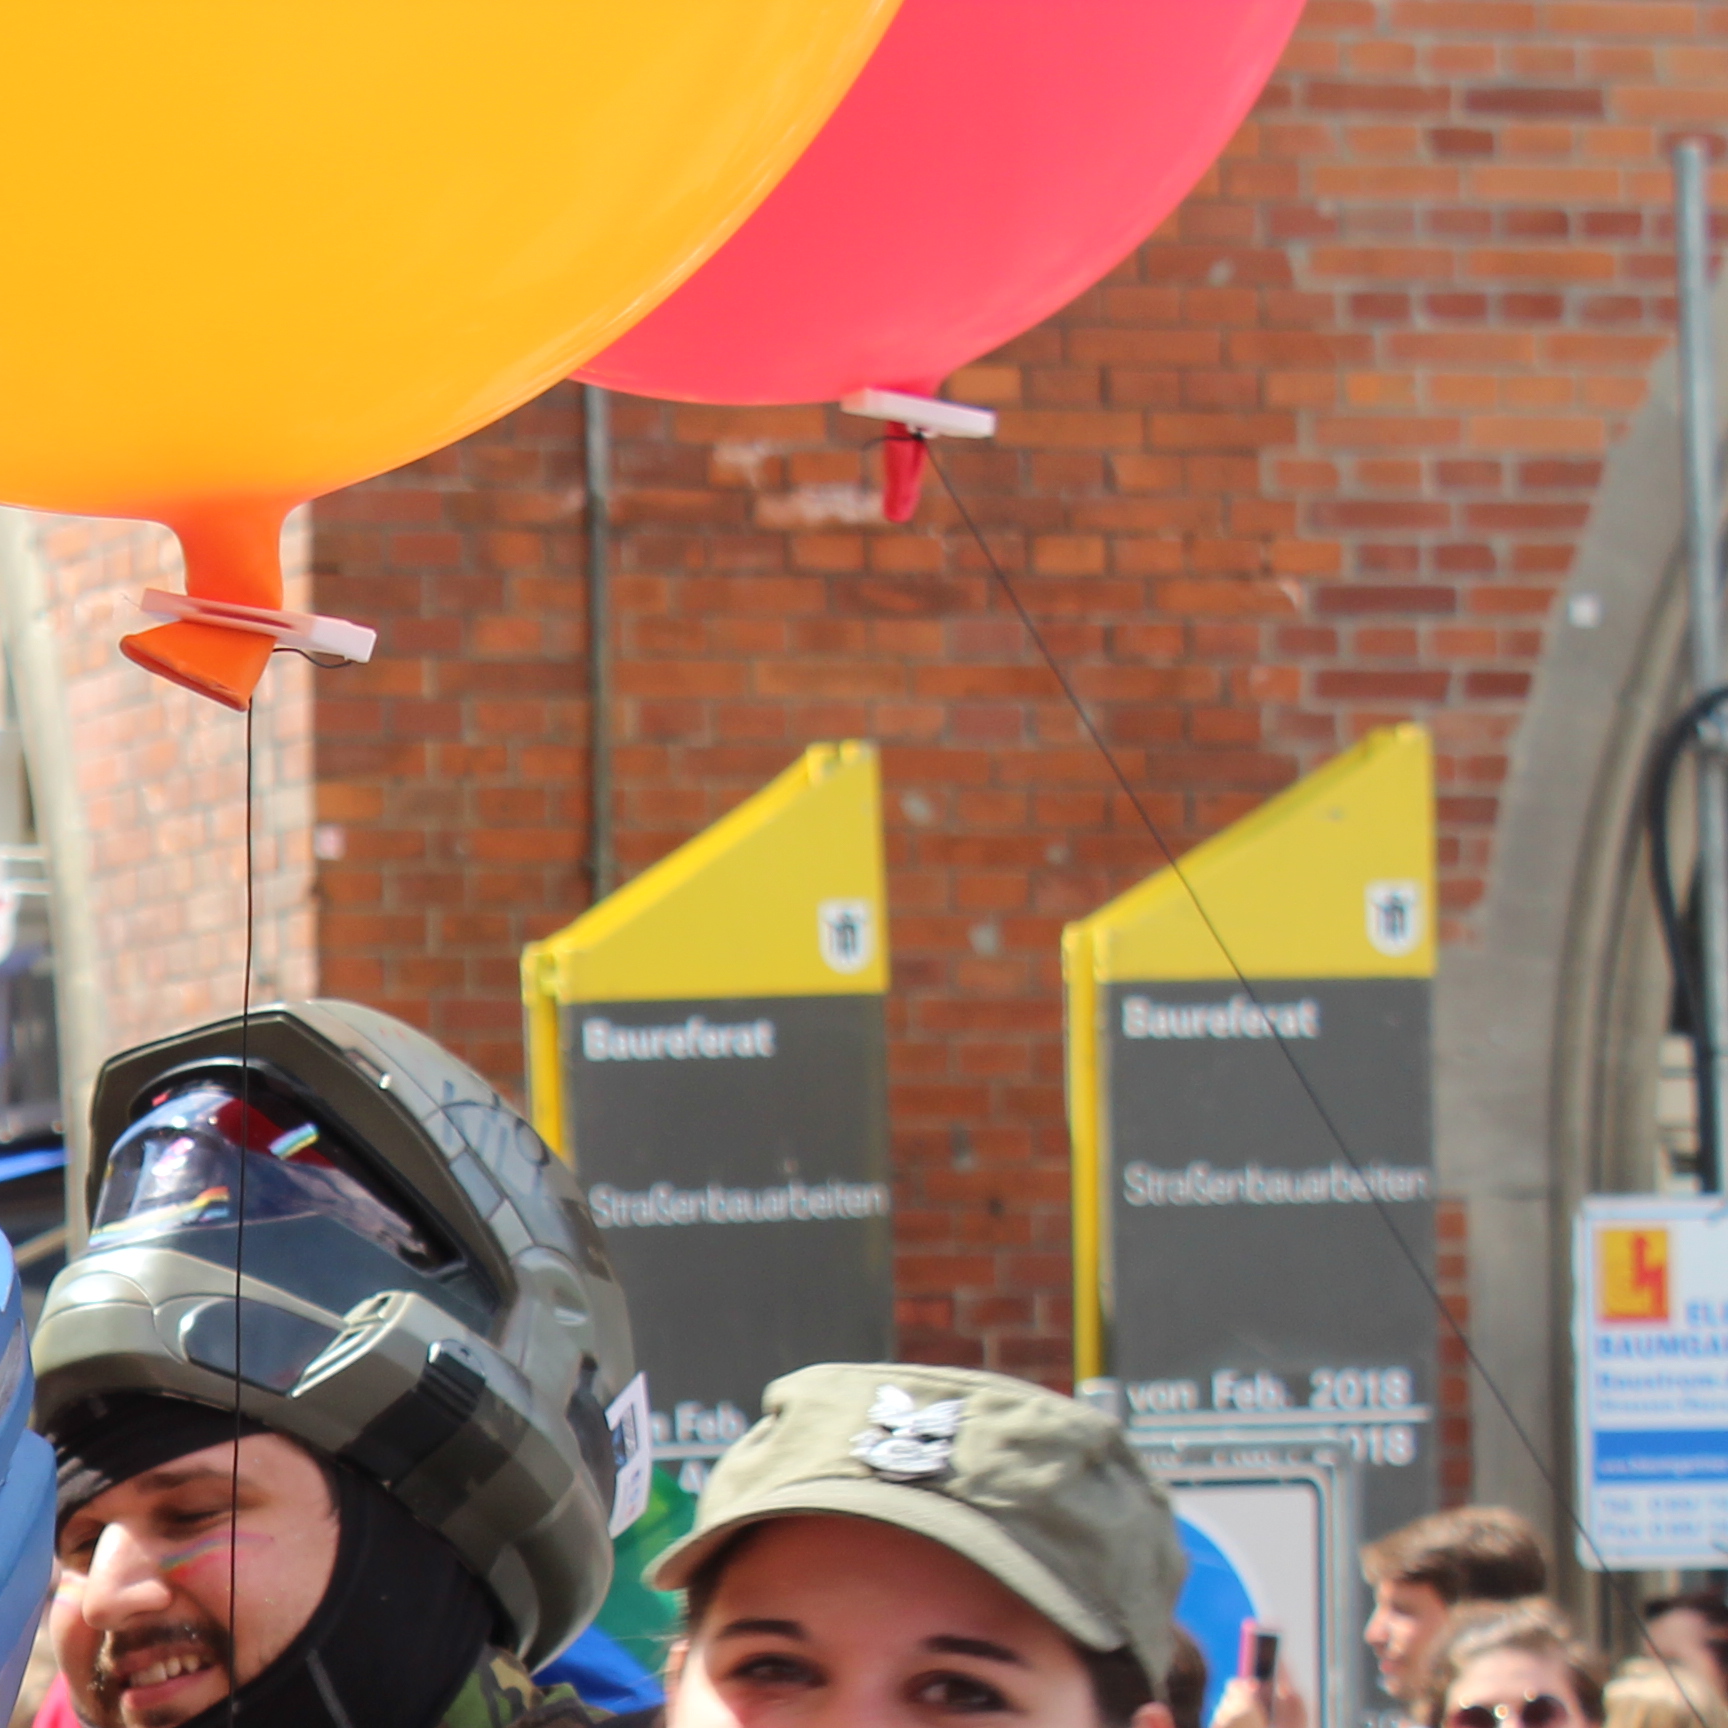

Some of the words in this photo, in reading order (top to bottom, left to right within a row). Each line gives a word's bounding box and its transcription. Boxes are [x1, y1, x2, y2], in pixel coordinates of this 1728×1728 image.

[582, 1016, 776, 1061] Baureferat
[1120, 995, 1321, 1040] Baureferat
[1596, 1333, 1728, 1360] BAUMGA
[1126, 1379, 1199, 1411] von
[1309, 1365, 1412, 1411] 2018
